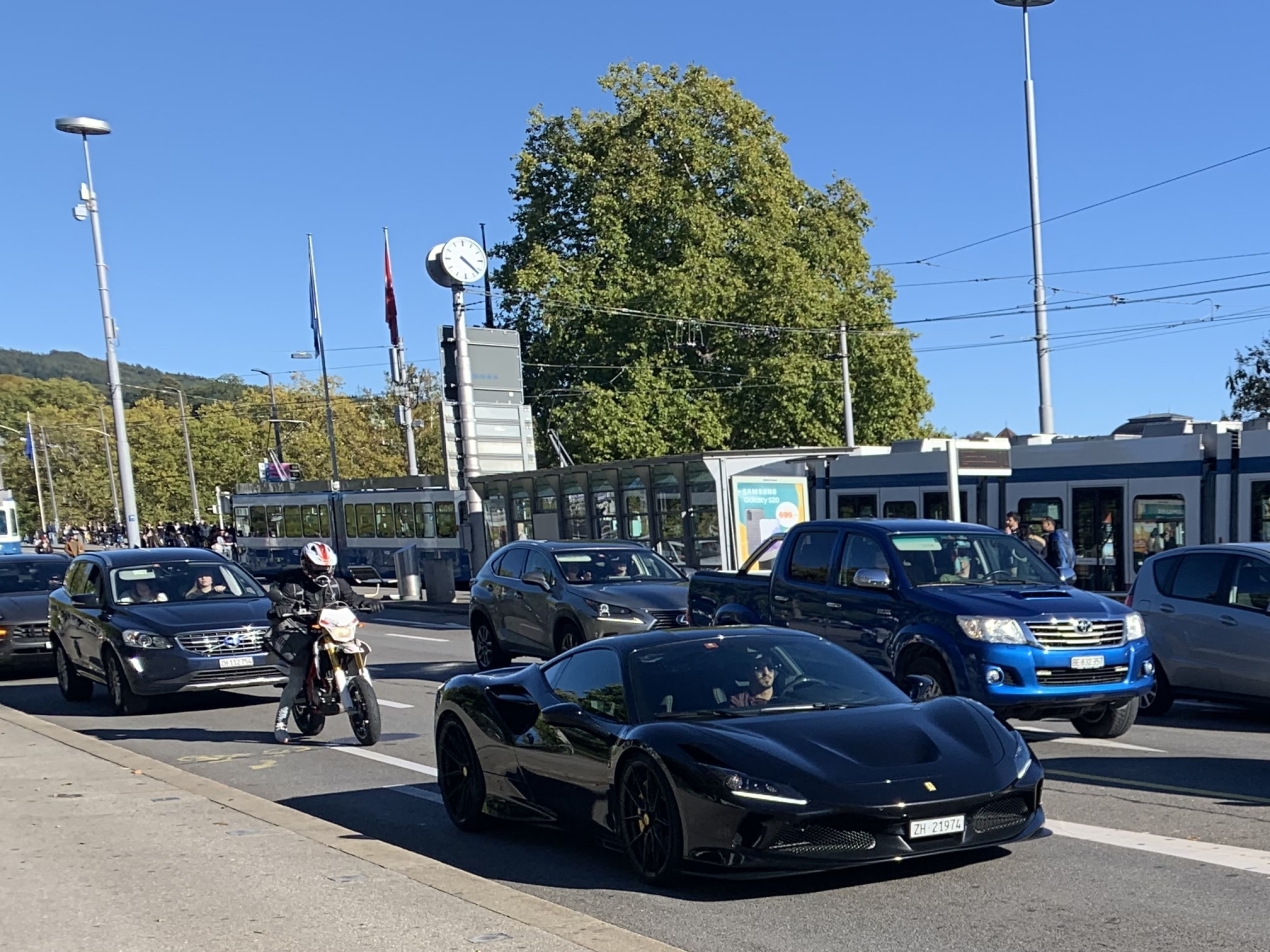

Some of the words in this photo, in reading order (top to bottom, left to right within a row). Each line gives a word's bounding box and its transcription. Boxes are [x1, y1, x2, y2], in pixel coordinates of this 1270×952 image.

[743, 496, 768, 505] Galaxy
[768, 496, 780, 504] S20
[913, 823, 926, 836] ZH
[932, 818, 961, 833] 21974
